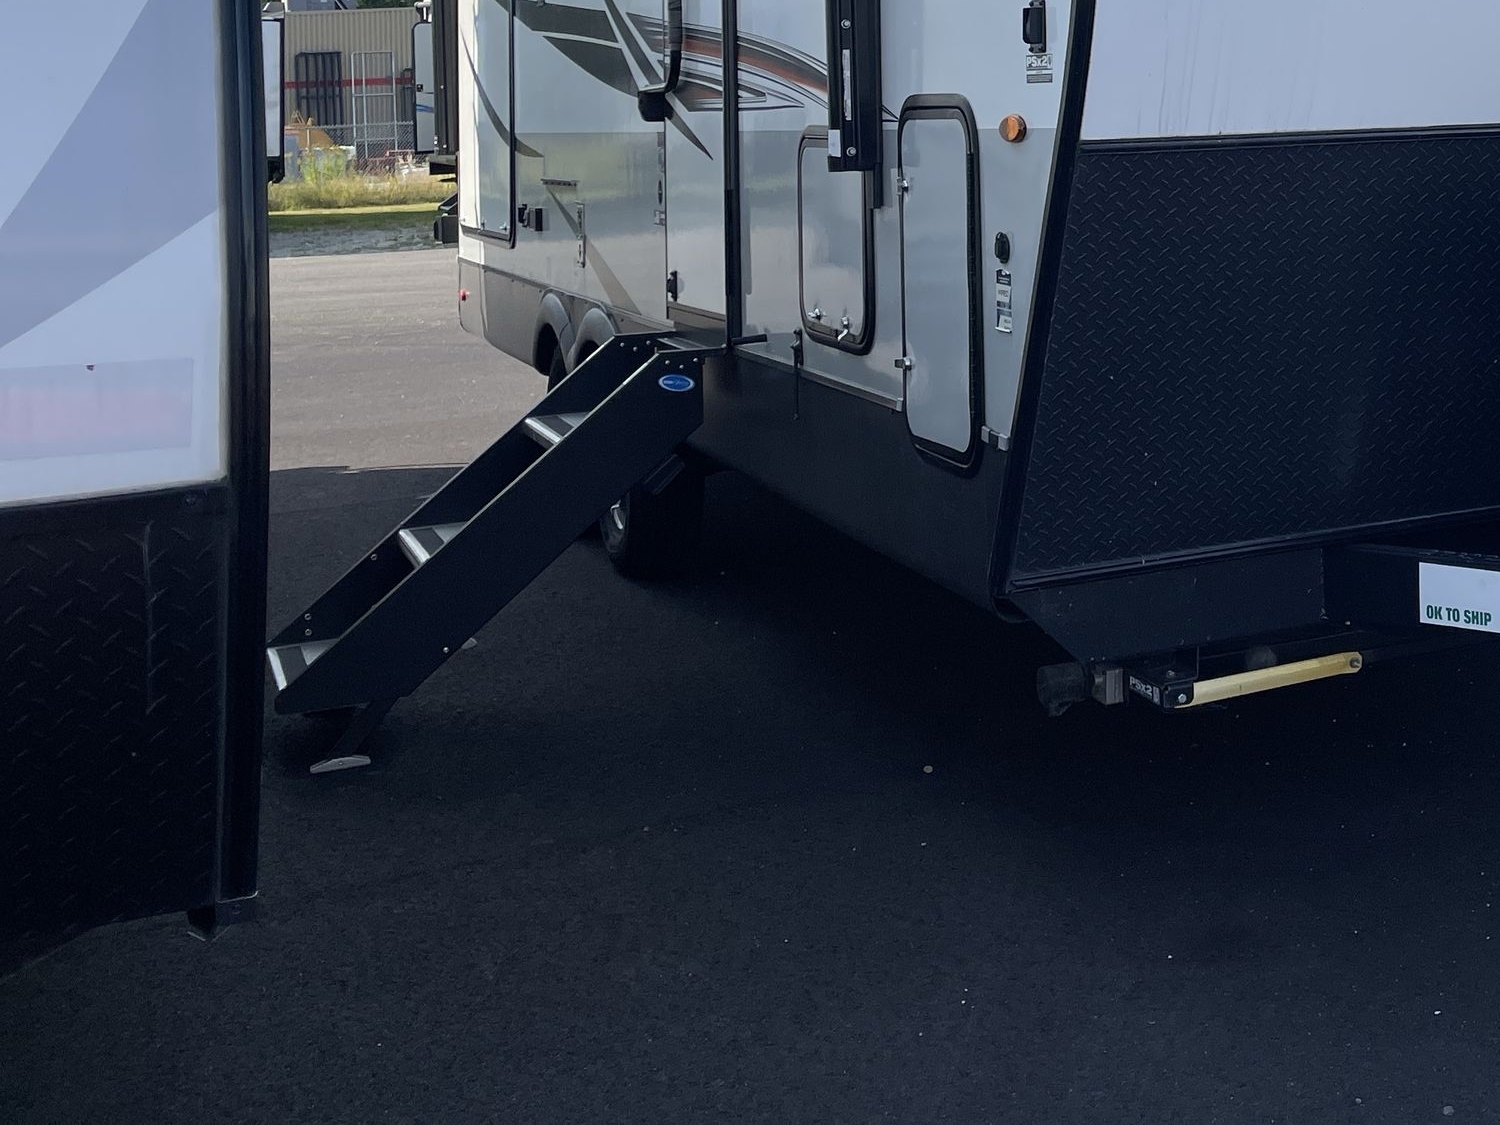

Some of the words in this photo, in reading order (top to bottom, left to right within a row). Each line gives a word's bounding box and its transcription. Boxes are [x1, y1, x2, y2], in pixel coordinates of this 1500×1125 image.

[1426, 604, 1442, 620] OK
[1445, 607, 1460, 623] TO
[1463, 609, 1492, 626] SHIP
